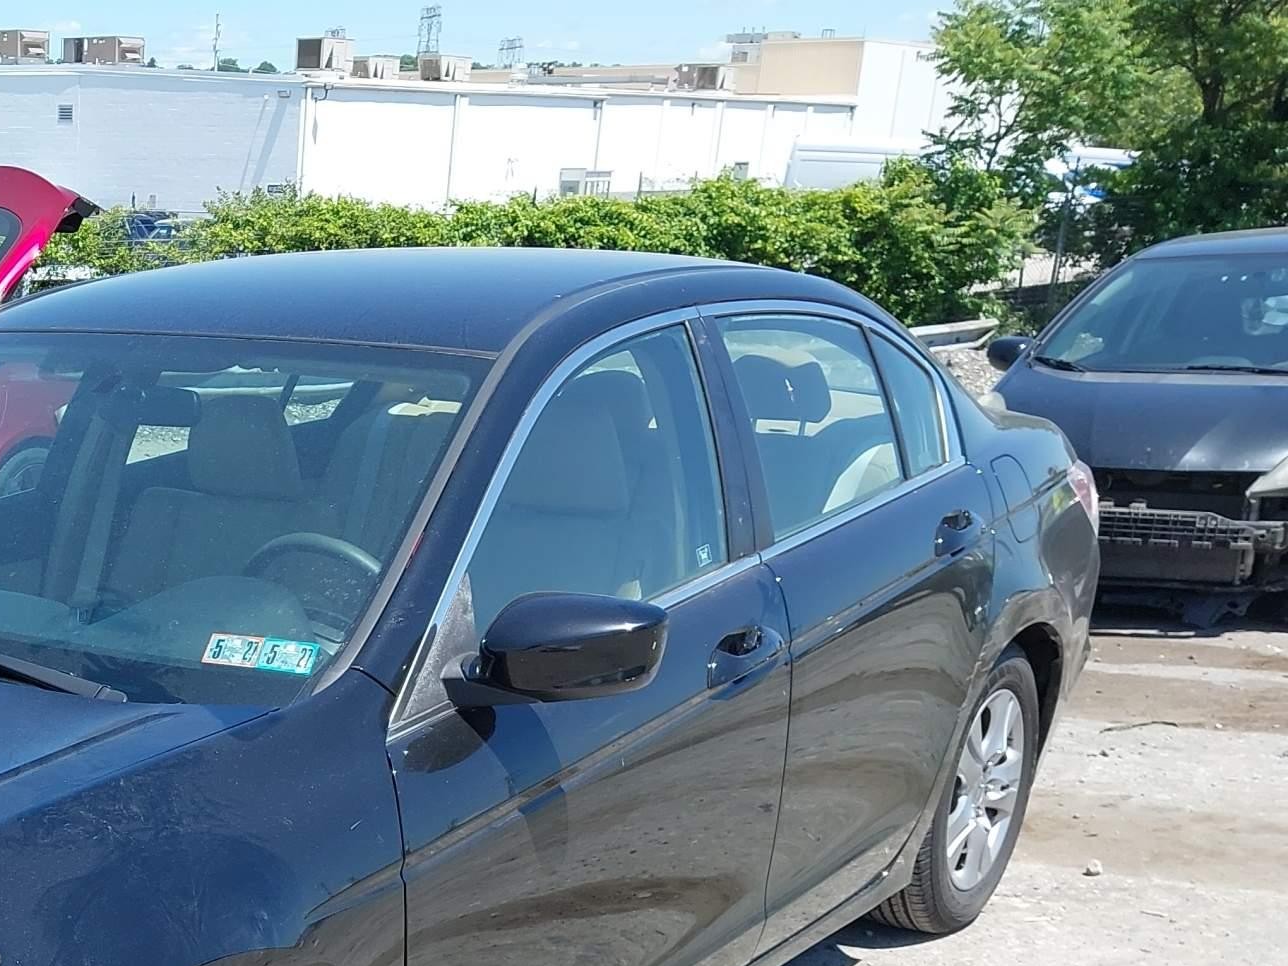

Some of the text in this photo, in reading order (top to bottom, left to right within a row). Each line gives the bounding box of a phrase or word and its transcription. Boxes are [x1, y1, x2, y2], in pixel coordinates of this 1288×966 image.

[211, 639, 226, 660] 5
[242, 641, 260, 663] 27
[266, 644, 281, 665] 5
[296, 647, 314, 669] 27
